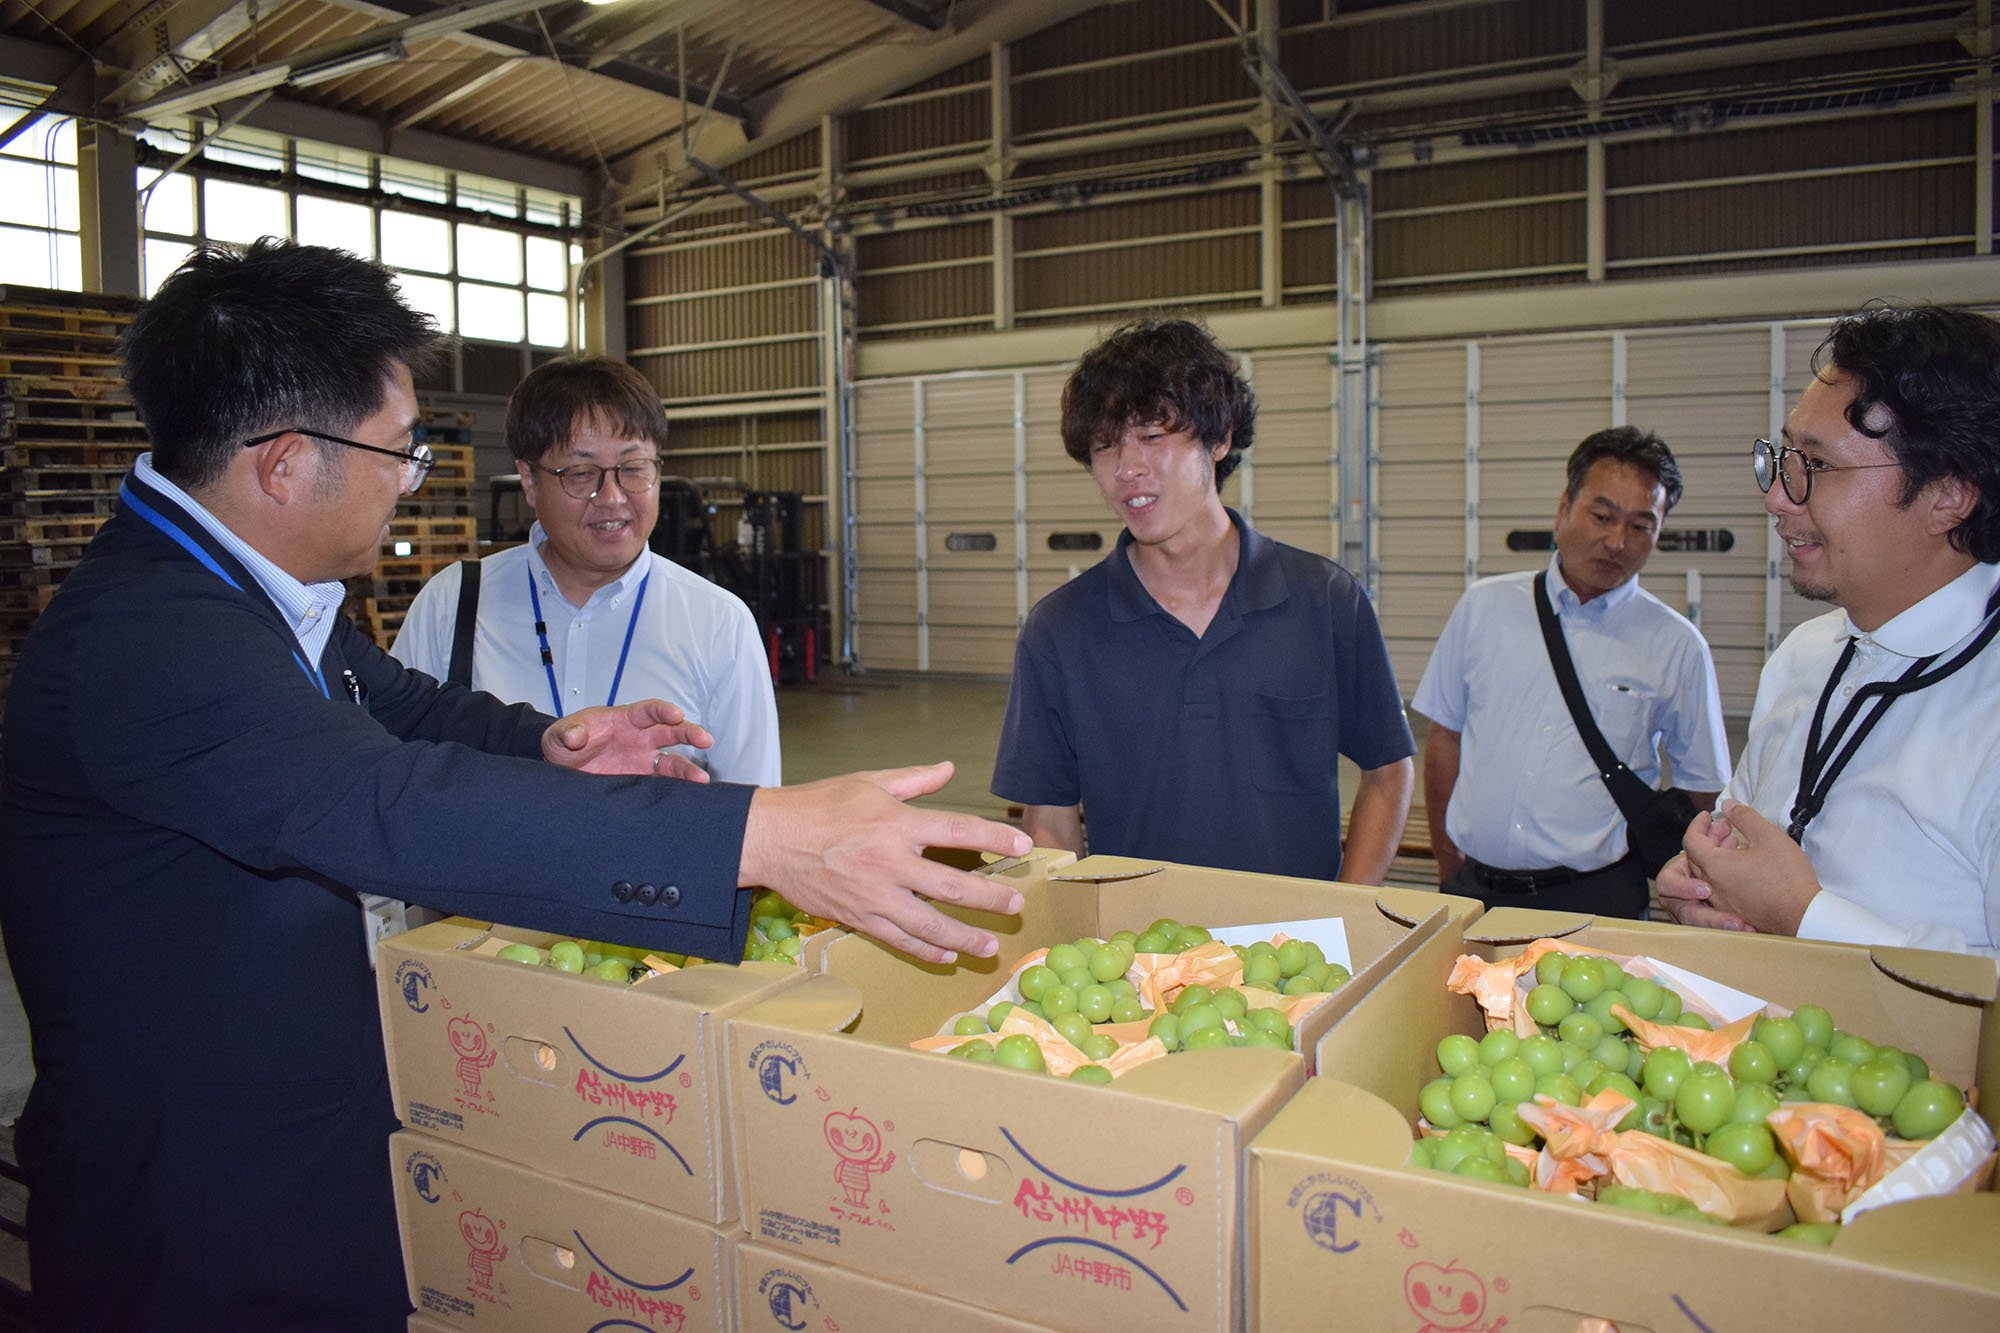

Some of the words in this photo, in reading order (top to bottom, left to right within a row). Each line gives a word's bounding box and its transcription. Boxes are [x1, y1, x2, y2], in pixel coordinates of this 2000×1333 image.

[576, 1068, 677, 1126] 信州中野
[603, 1129, 657, 1160] JA中野市
[1013, 1177, 1169, 1249] 信州中野
[1051, 1251, 1133, 1292] JA中野市
[586, 1271, 687, 1333] 信州中野
